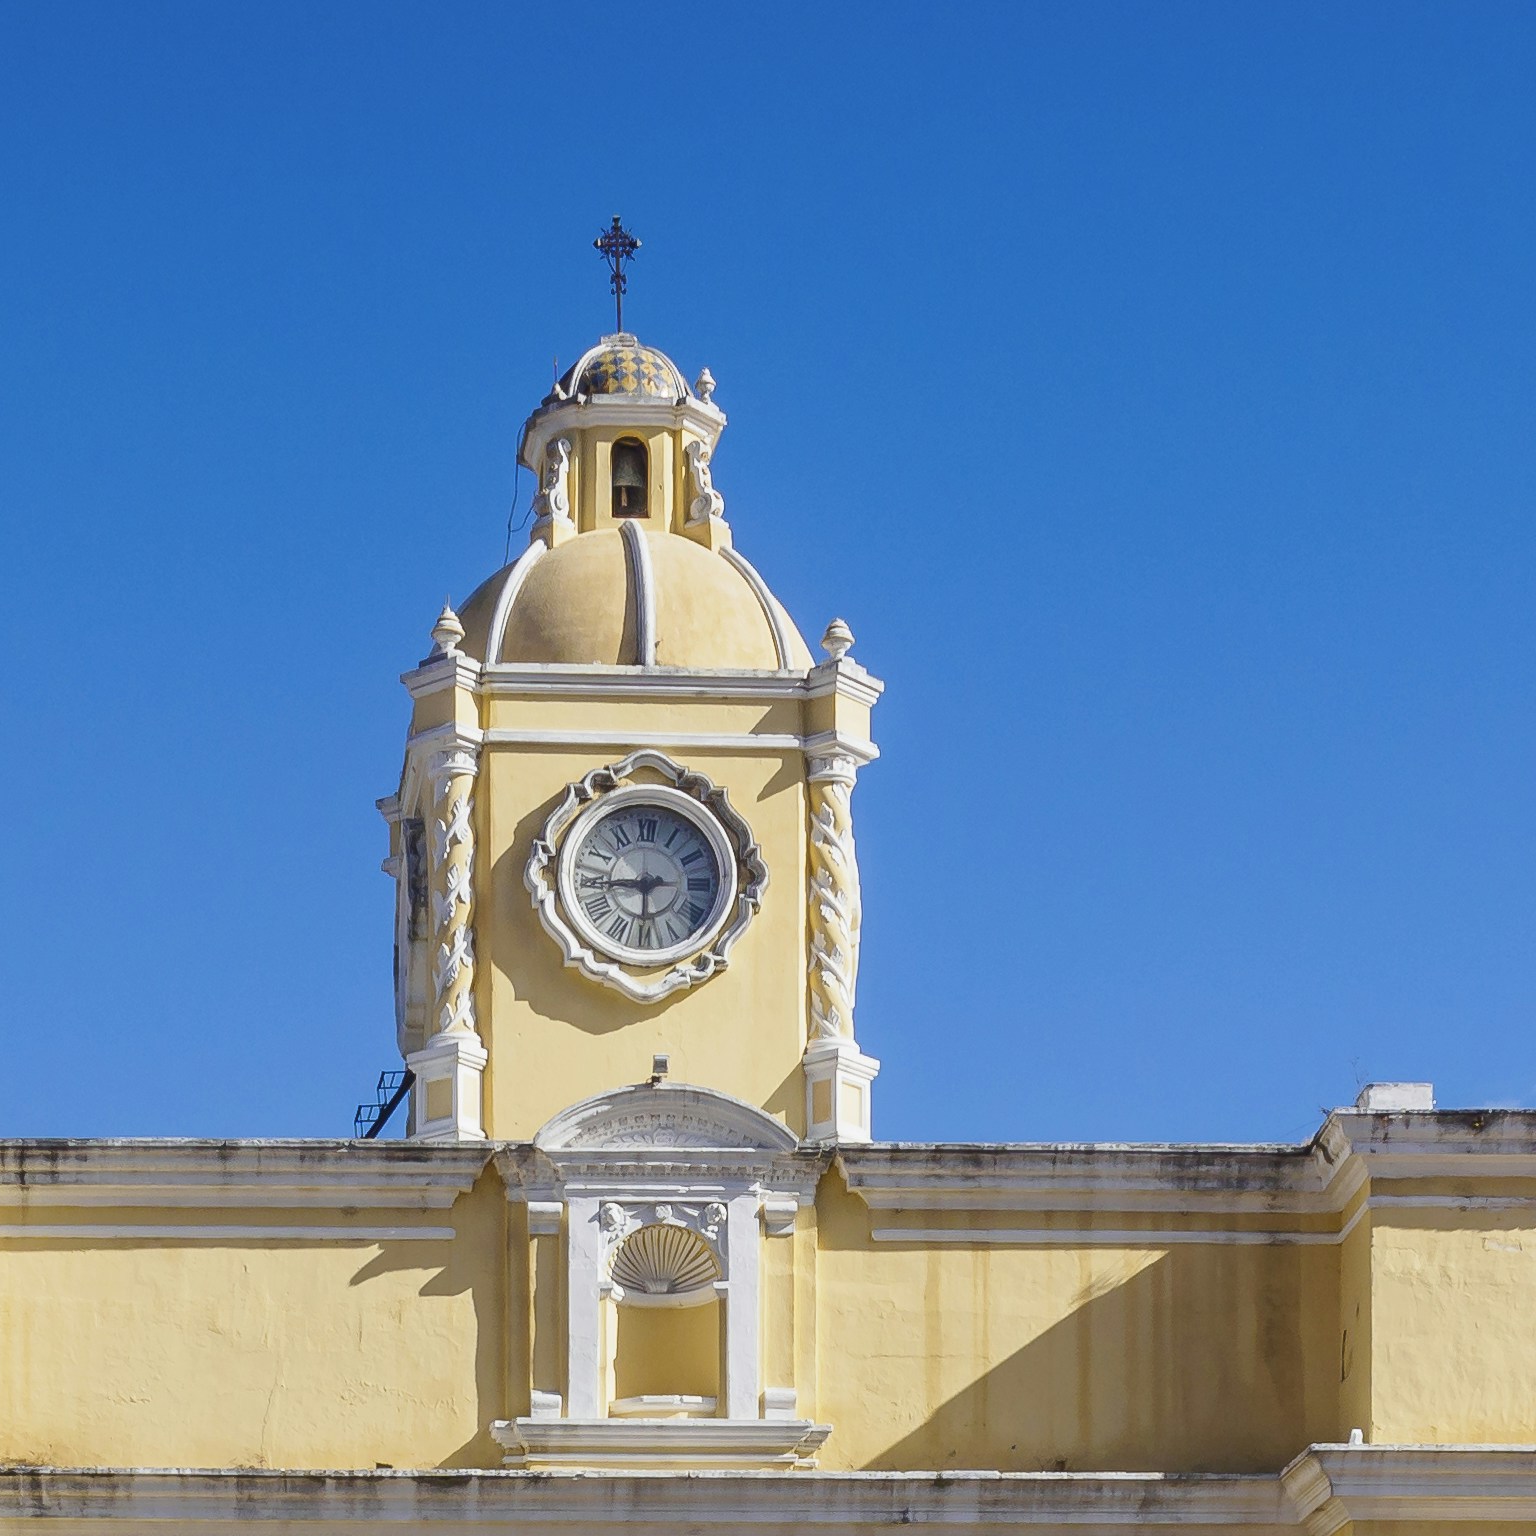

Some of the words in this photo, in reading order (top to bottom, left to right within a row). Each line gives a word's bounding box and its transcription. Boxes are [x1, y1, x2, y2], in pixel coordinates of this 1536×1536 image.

[609, 824, 632, 851] XI
[636, 818, 659, 843] XII
[665, 827, 680, 849] I
[588, 845, 612, 865] X
[680, 848, 704, 868] II
[687, 877, 711, 892] III
[584, 894, 612, 924] VIII
[606, 914, 629, 942] VII
[665, 920, 680, 942] V
